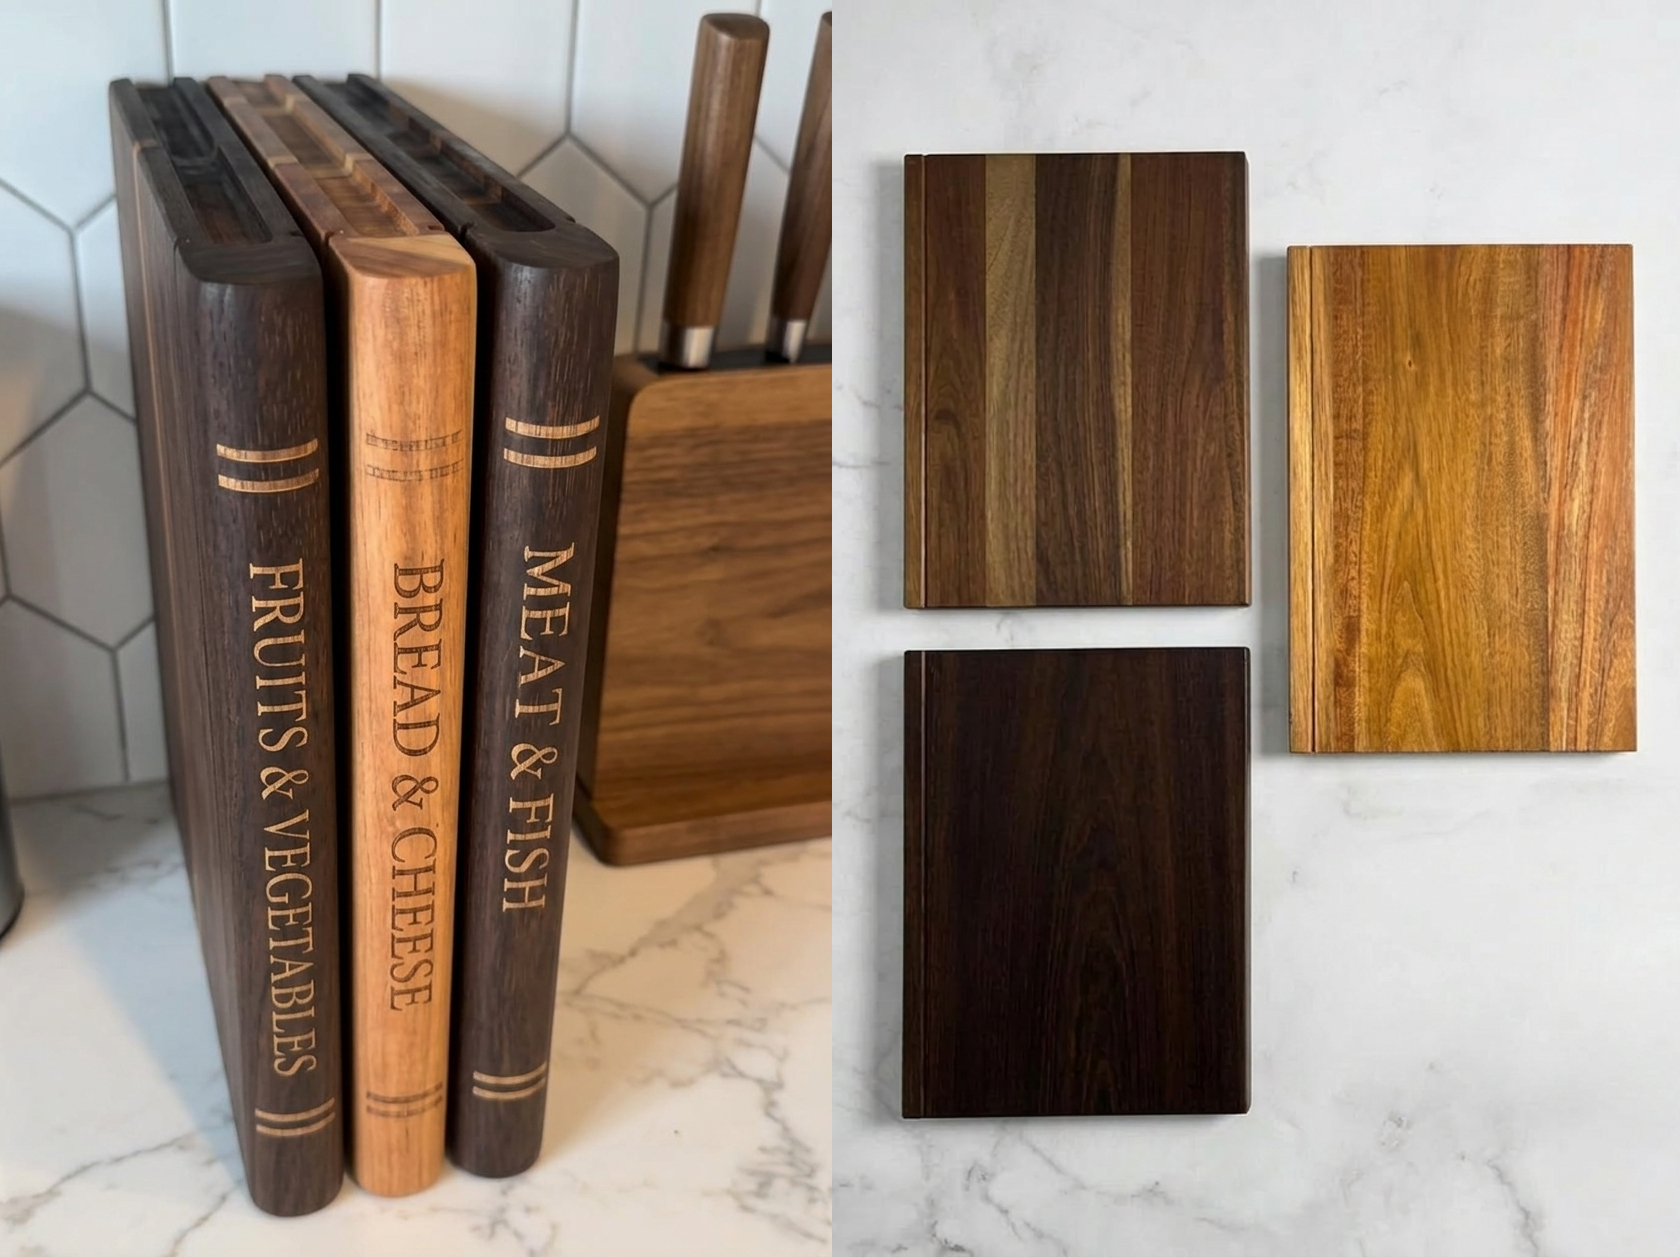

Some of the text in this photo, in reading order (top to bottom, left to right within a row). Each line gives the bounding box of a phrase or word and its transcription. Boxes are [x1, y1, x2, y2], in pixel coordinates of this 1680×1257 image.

[249, 558, 317, 1077] FRUITS & VEGETABLES
[389, 558, 444, 1012] BREAD & CHEESE
[502, 542, 575, 913] MEAT & FISH
